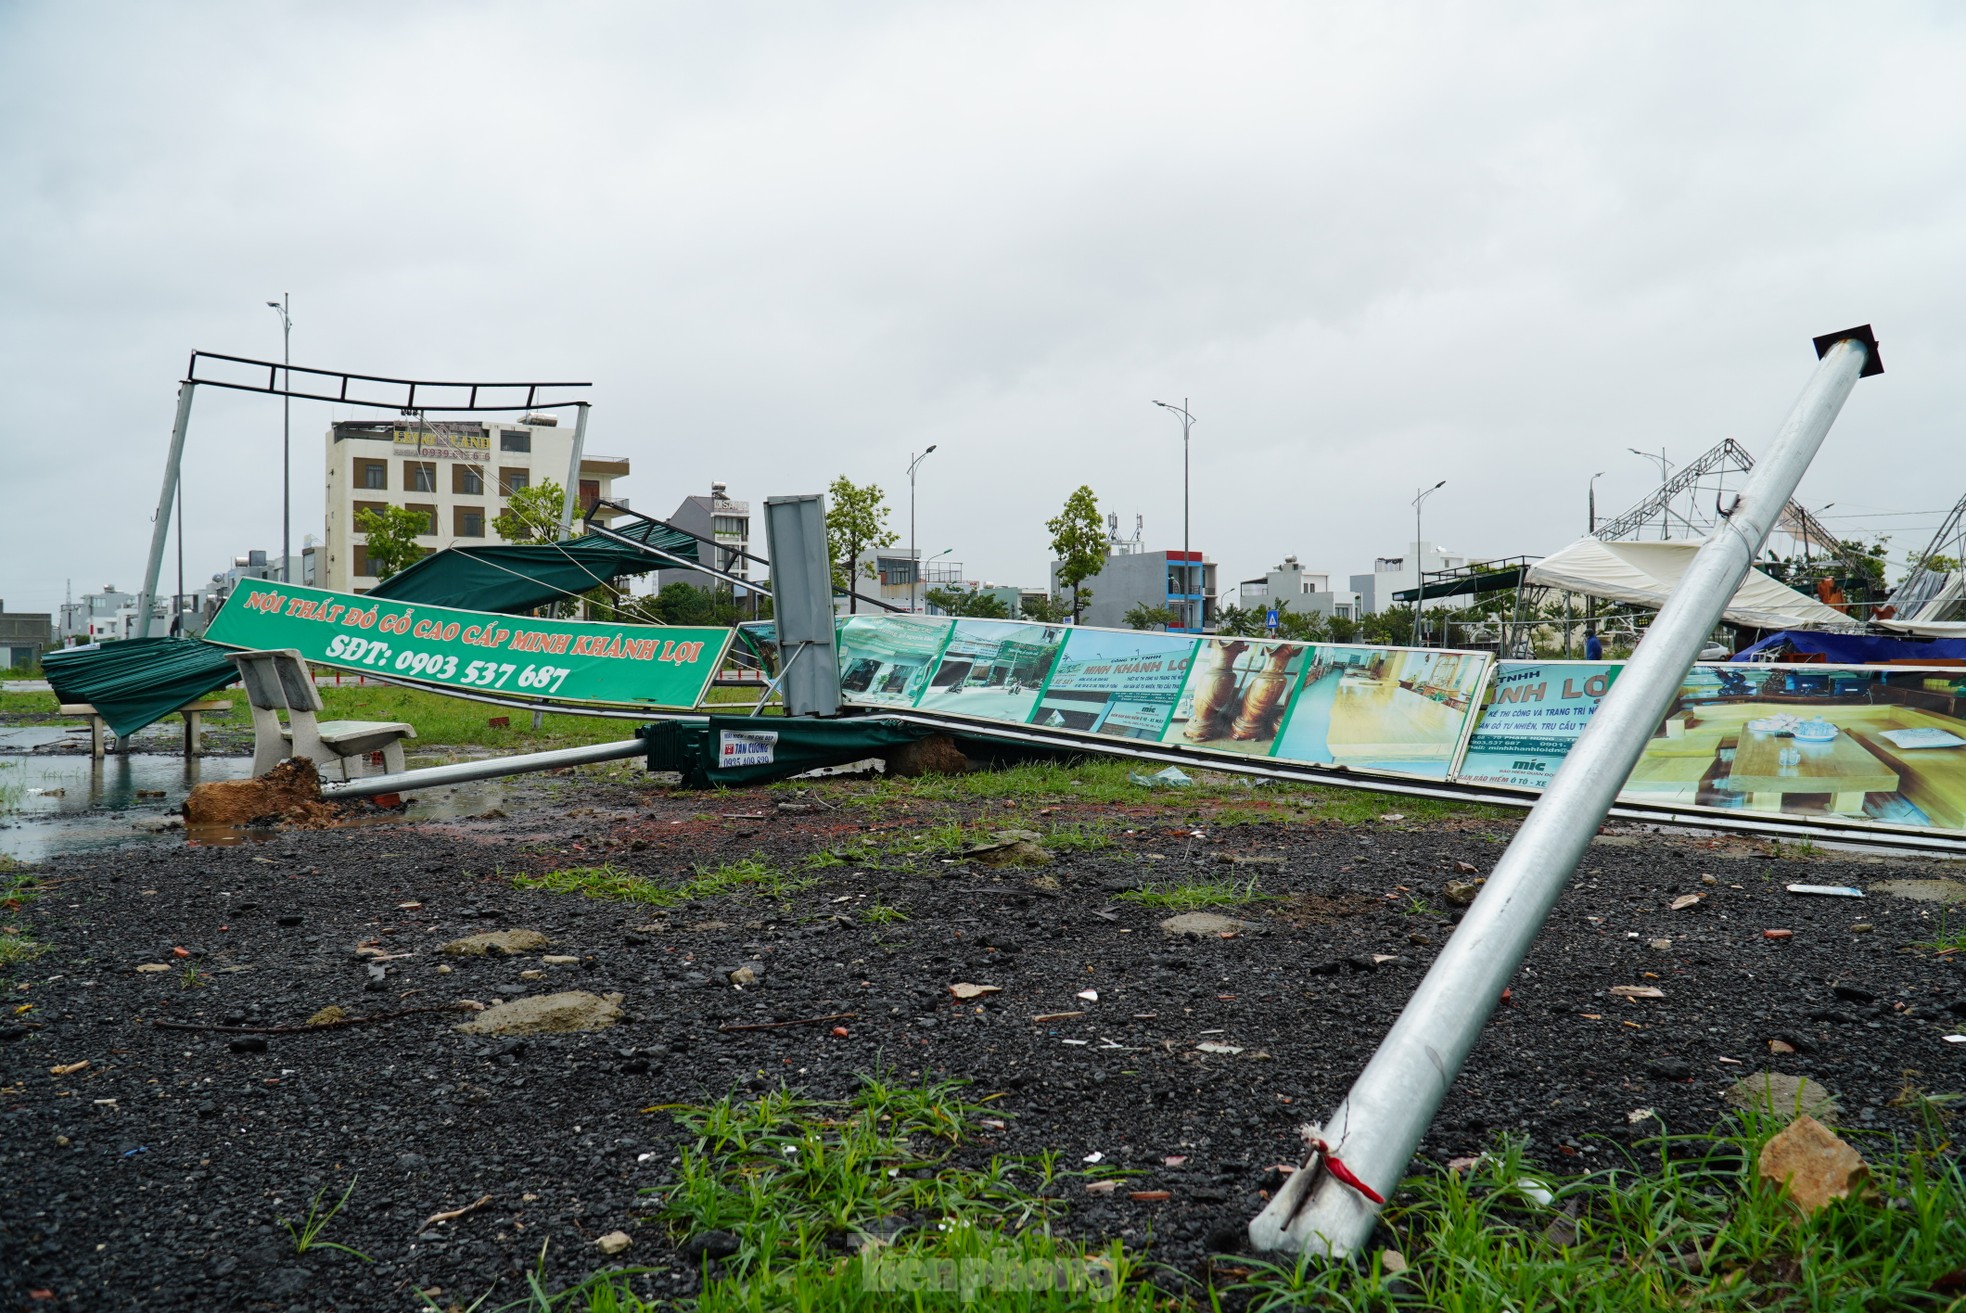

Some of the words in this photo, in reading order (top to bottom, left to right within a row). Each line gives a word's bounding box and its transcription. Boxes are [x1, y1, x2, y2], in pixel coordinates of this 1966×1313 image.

[244, 590, 287, 614] NỘI
[286, 598, 344, 622] THẤT
[378, 608, 414, 635] GỖ
[413, 619, 460, 642] CAO
[462, 620, 509, 648] CẤP
[508, 630, 573, 654] MINH
[570, 633, 659, 661] KHÁNH
[658, 641, 704, 666] LỢI
[326, 634, 392, 666] SĐT:
[395, 650, 459, 680] 0903
[460, 660, 516, 688] 537
[518, 664, 571, 693] 687
[1083, 664, 1112, 675] MINH
[1113, 660, 1162, 674] KHÁNH
[1167, 656, 1191, 674] LỢ
[1498, 671, 1540, 684] TNHH
[1562, 670, 1610, 704] LỢ
[1512, 708, 1531, 717] CÔNG
[1546, 707, 1570, 716] TRANG
[1488, 745, 1569, 754] minhkhanhloidn@
